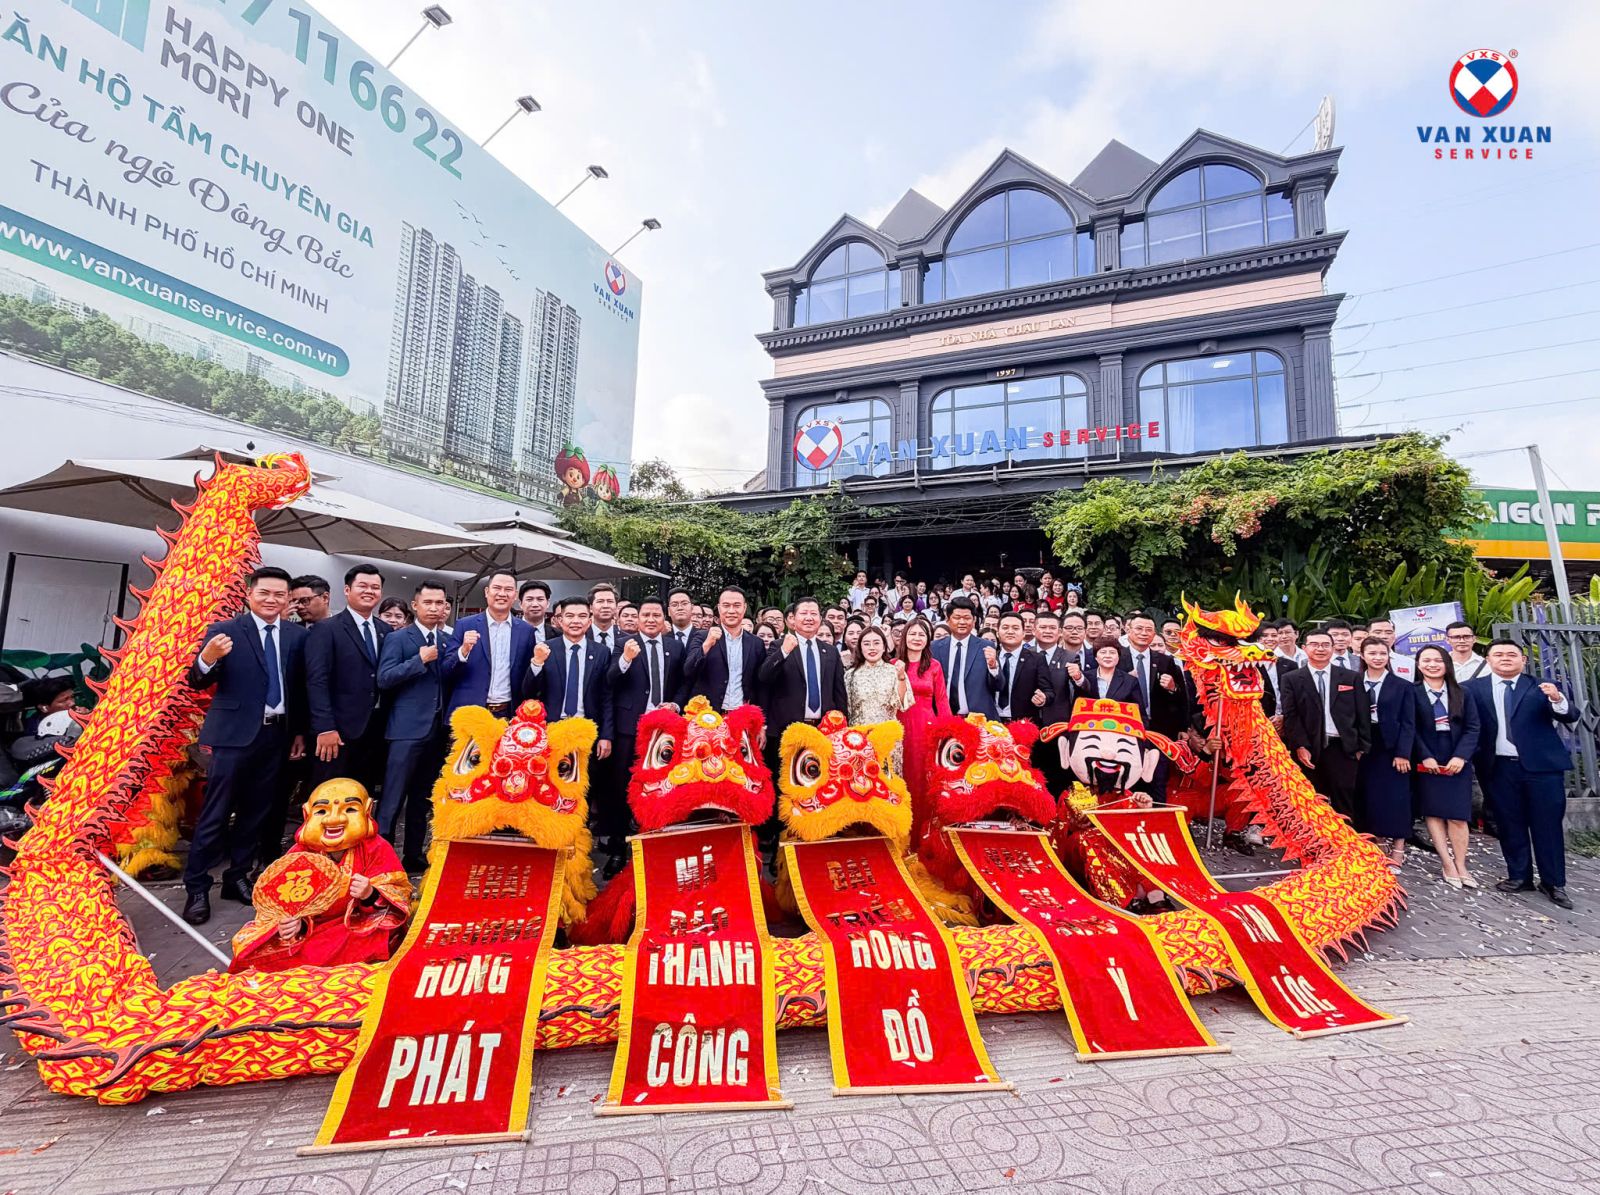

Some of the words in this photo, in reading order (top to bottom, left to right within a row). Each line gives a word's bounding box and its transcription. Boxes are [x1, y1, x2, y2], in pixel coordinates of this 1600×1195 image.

[160, 38, 251, 120] MORI
[165, 5, 290, 108] HAPPY
[296, 100, 354, 157] ONE
[0, 10, 68, 72] ĂN
[78, 58, 132, 111] HỘ
[220, 143, 331, 223] CHUYÊN
[337, 212, 374, 248] GIA
[30, 159, 137, 226] THÀNH
[144, 214, 199, 252] PHỐ
[203, 242, 235, 270] HỒ
[240, 260, 276, 290] CHÍ
[281, 279, 329, 314] MINH
[104, 139, 181, 188] ngõ
[188, 177, 293, 255] Đông
[296, 234, 354, 279] Bắc
[0, 221, 338, 368] www.vanxuanservice.com.vn
[593, 282, 611, 303] VAN
[614, 297, 634, 320] XUAN
[1048, 316, 1077, 330] LAN
[996, 368, 1016, 377] 1997
[854, 438, 918, 466] VAN
[930, 426, 1027, 459] XUAN
[1043, 421, 1160, 448] SERVICE
[276, 868, 314, 903] 福
[377, 1020, 502, 1109] PHÁT
[647, 1012, 750, 1088] CÔNG
